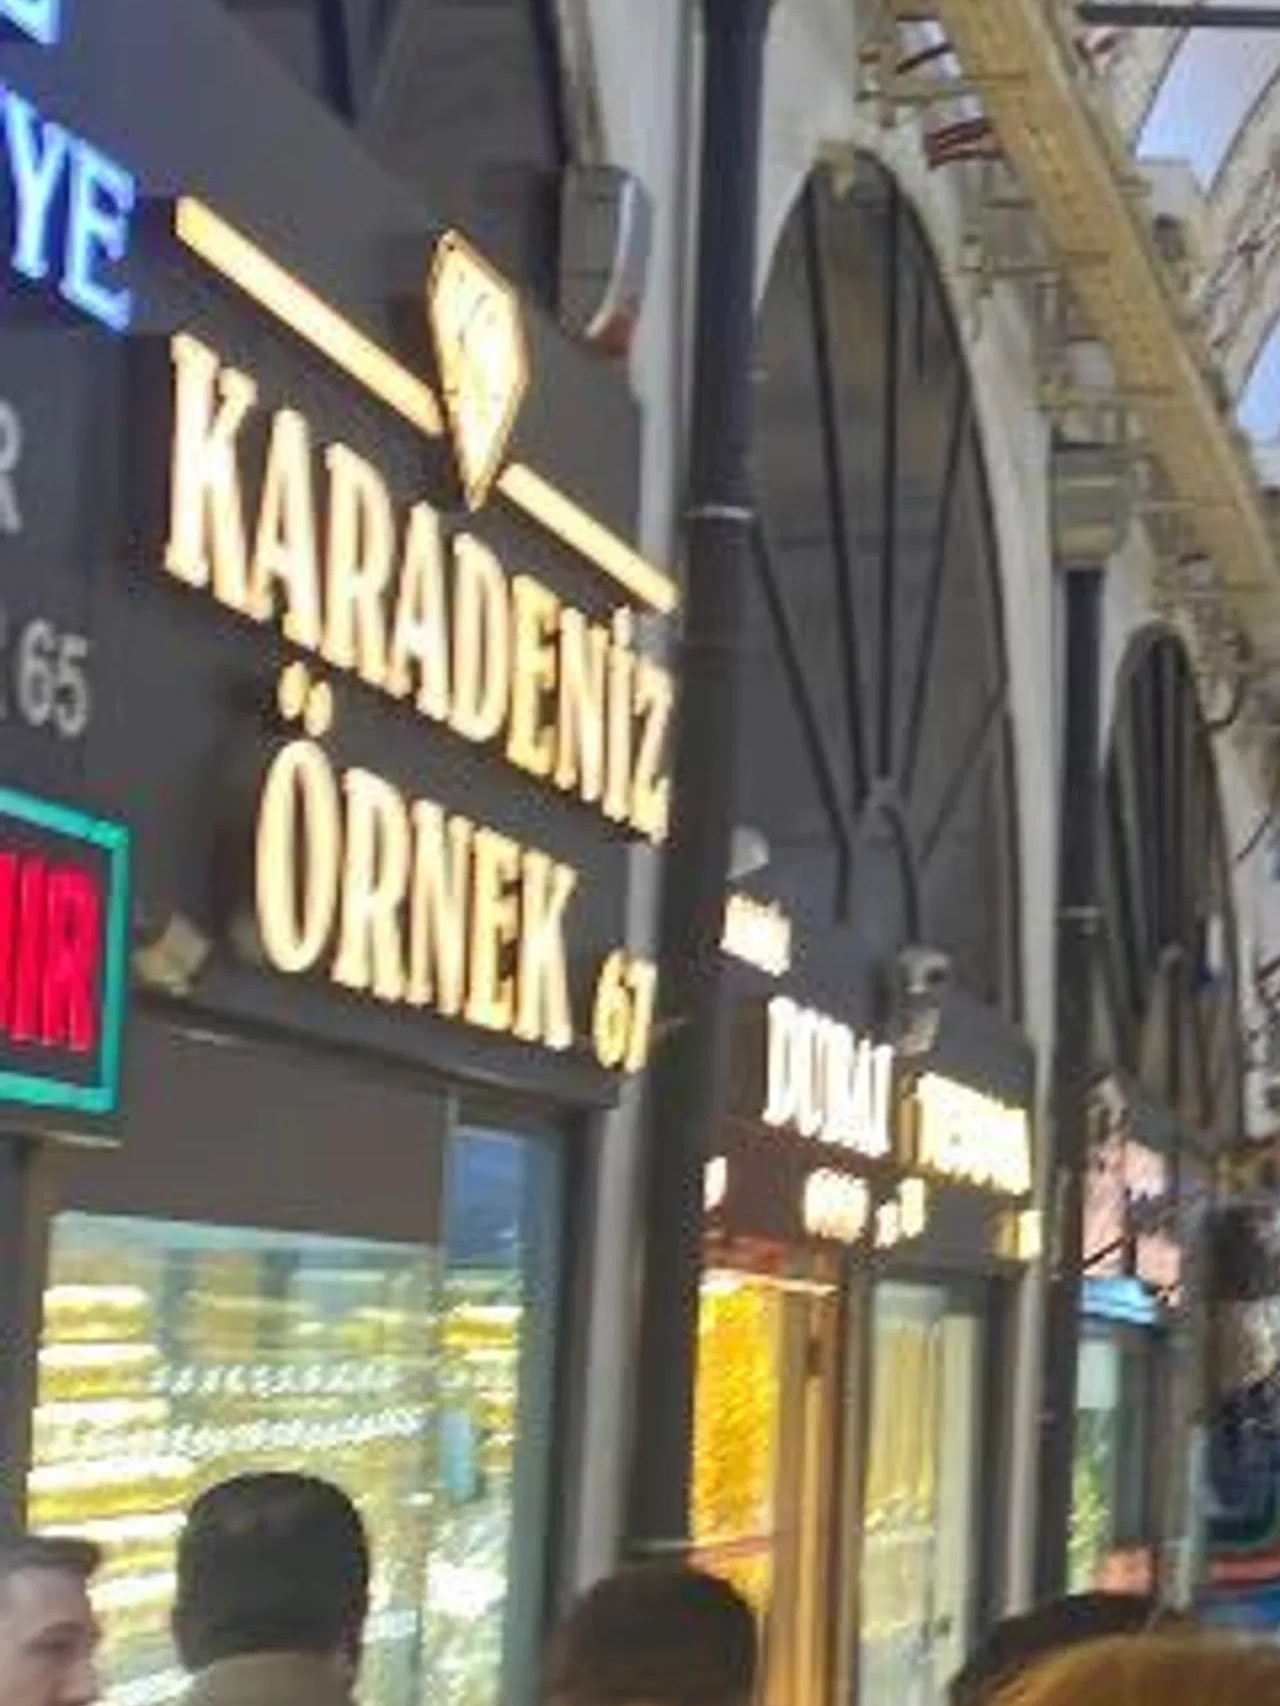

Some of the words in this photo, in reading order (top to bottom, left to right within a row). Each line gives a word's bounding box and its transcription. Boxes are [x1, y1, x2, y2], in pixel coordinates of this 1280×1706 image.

[18, 616, 90, 738] 65
[164, 330, 678, 845] KARADENİZ
[254, 659, 578, 1052] ÖRNEK
[591, 948, 658, 1074] 67
